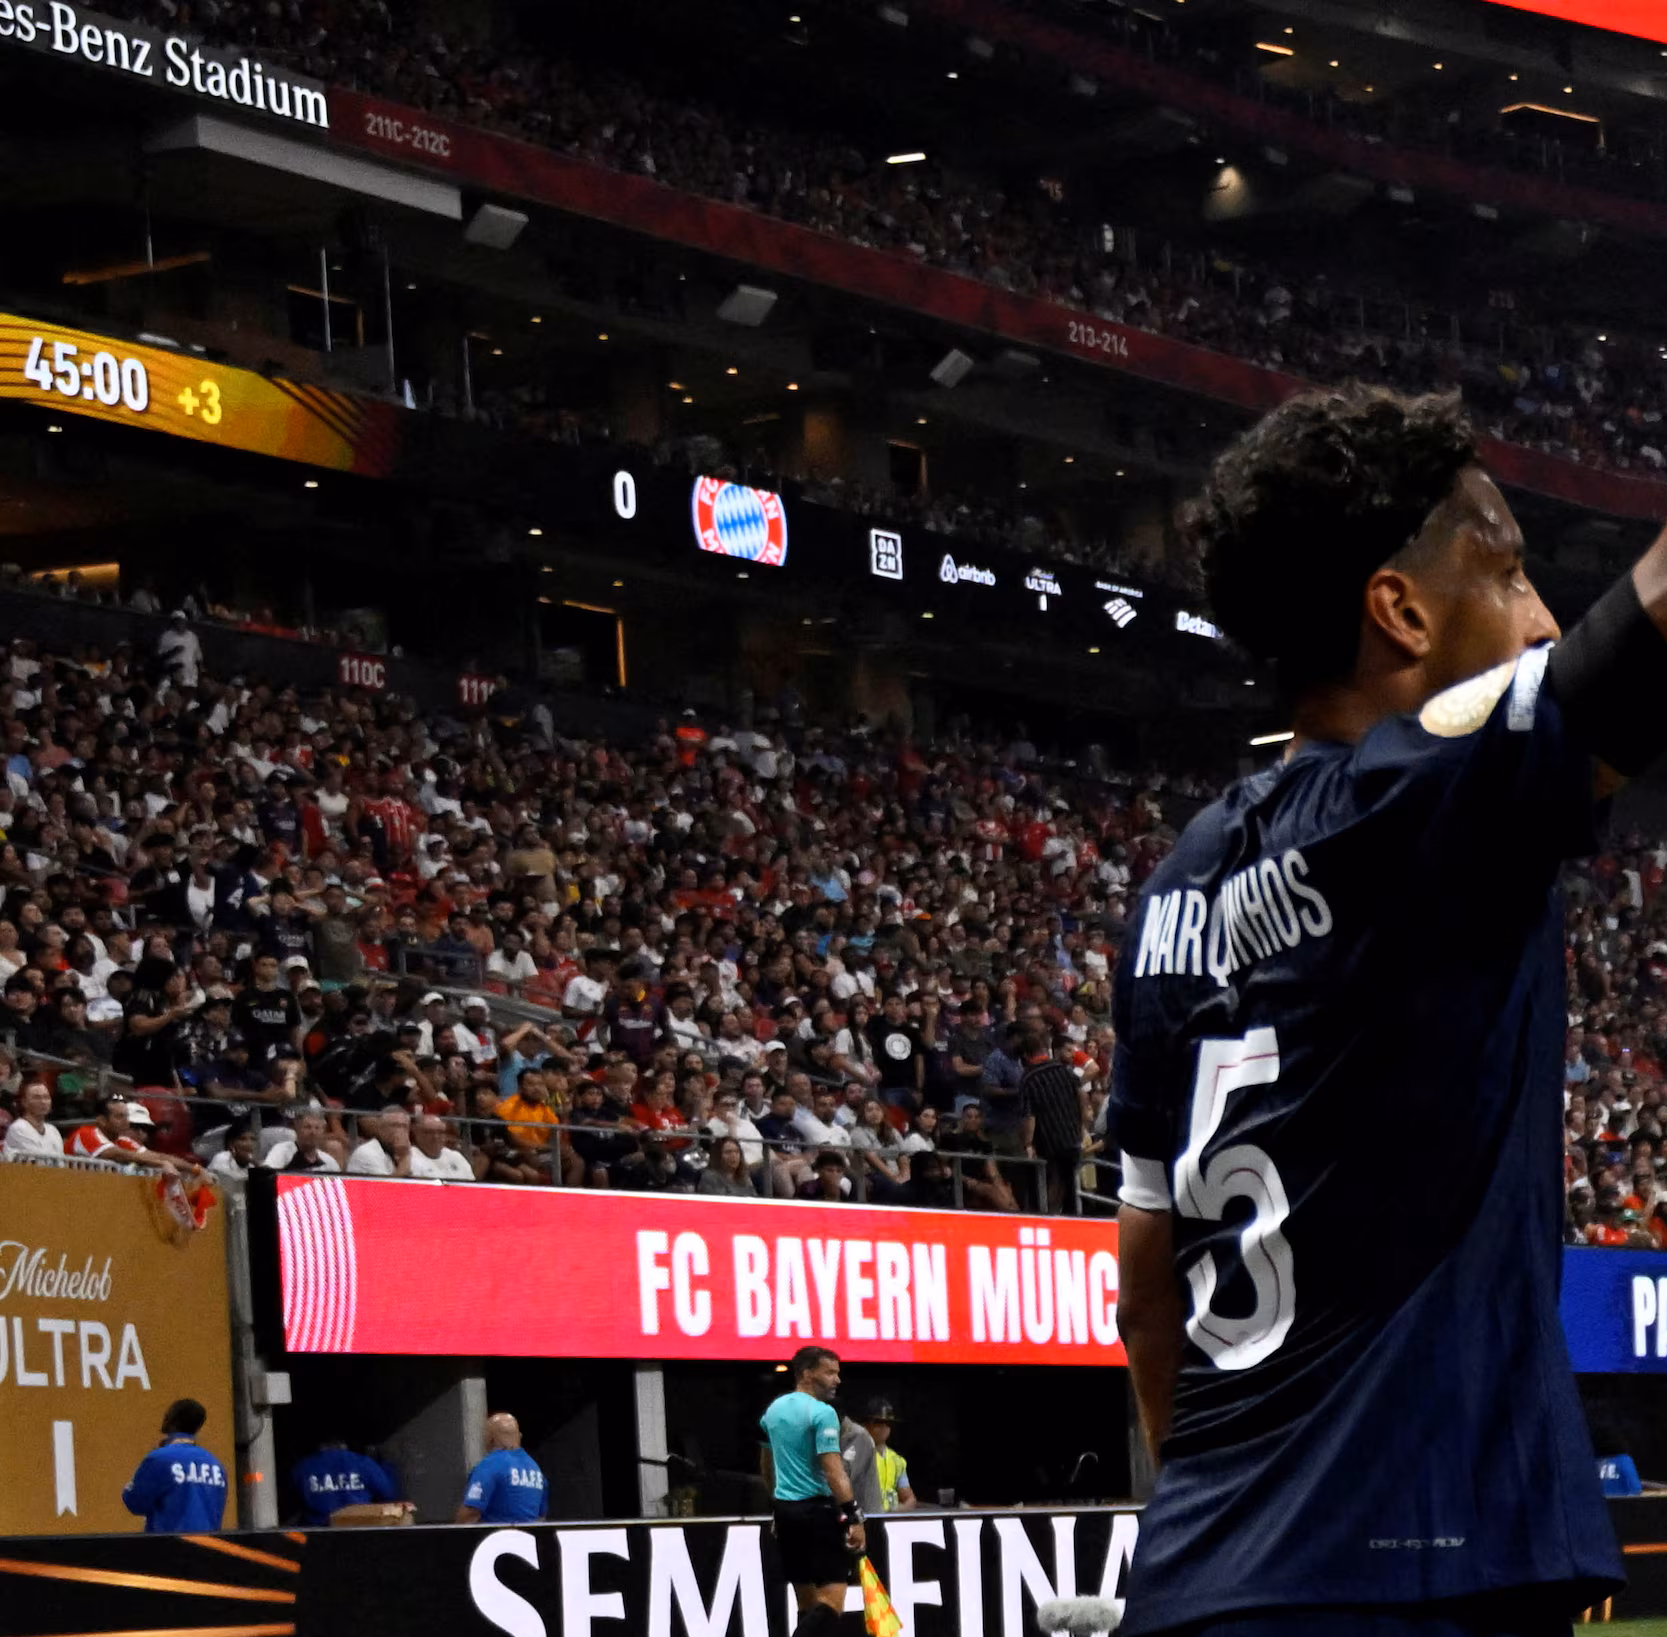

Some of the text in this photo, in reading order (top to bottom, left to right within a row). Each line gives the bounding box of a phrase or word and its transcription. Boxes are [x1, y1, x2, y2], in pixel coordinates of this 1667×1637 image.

[165, 36, 330, 130] Stadium
[365, 112, 451, 157] 211C-212C
[1068, 320, 1129, 359] 213-214
[24, 336, 223, 425] 45:00 +3
[613, 470, 637, 519] 0
[957, 562, 996, 586] airbnb
[1025, 575, 1062, 596] ULTRA
[340, 655, 386, 688] 110C
[1134, 848, 1334, 988] MARQINHOS
[1173, 1025, 1297, 1371] 5
[0, 1240, 113, 1301] Michelob
[635, 1227, 1120, 1346] FC BAYERN MÜNC
[170, 1461, 226, 1487] S.A.F.E.
[308, 1473, 365, 1492] S.A.F.E.
